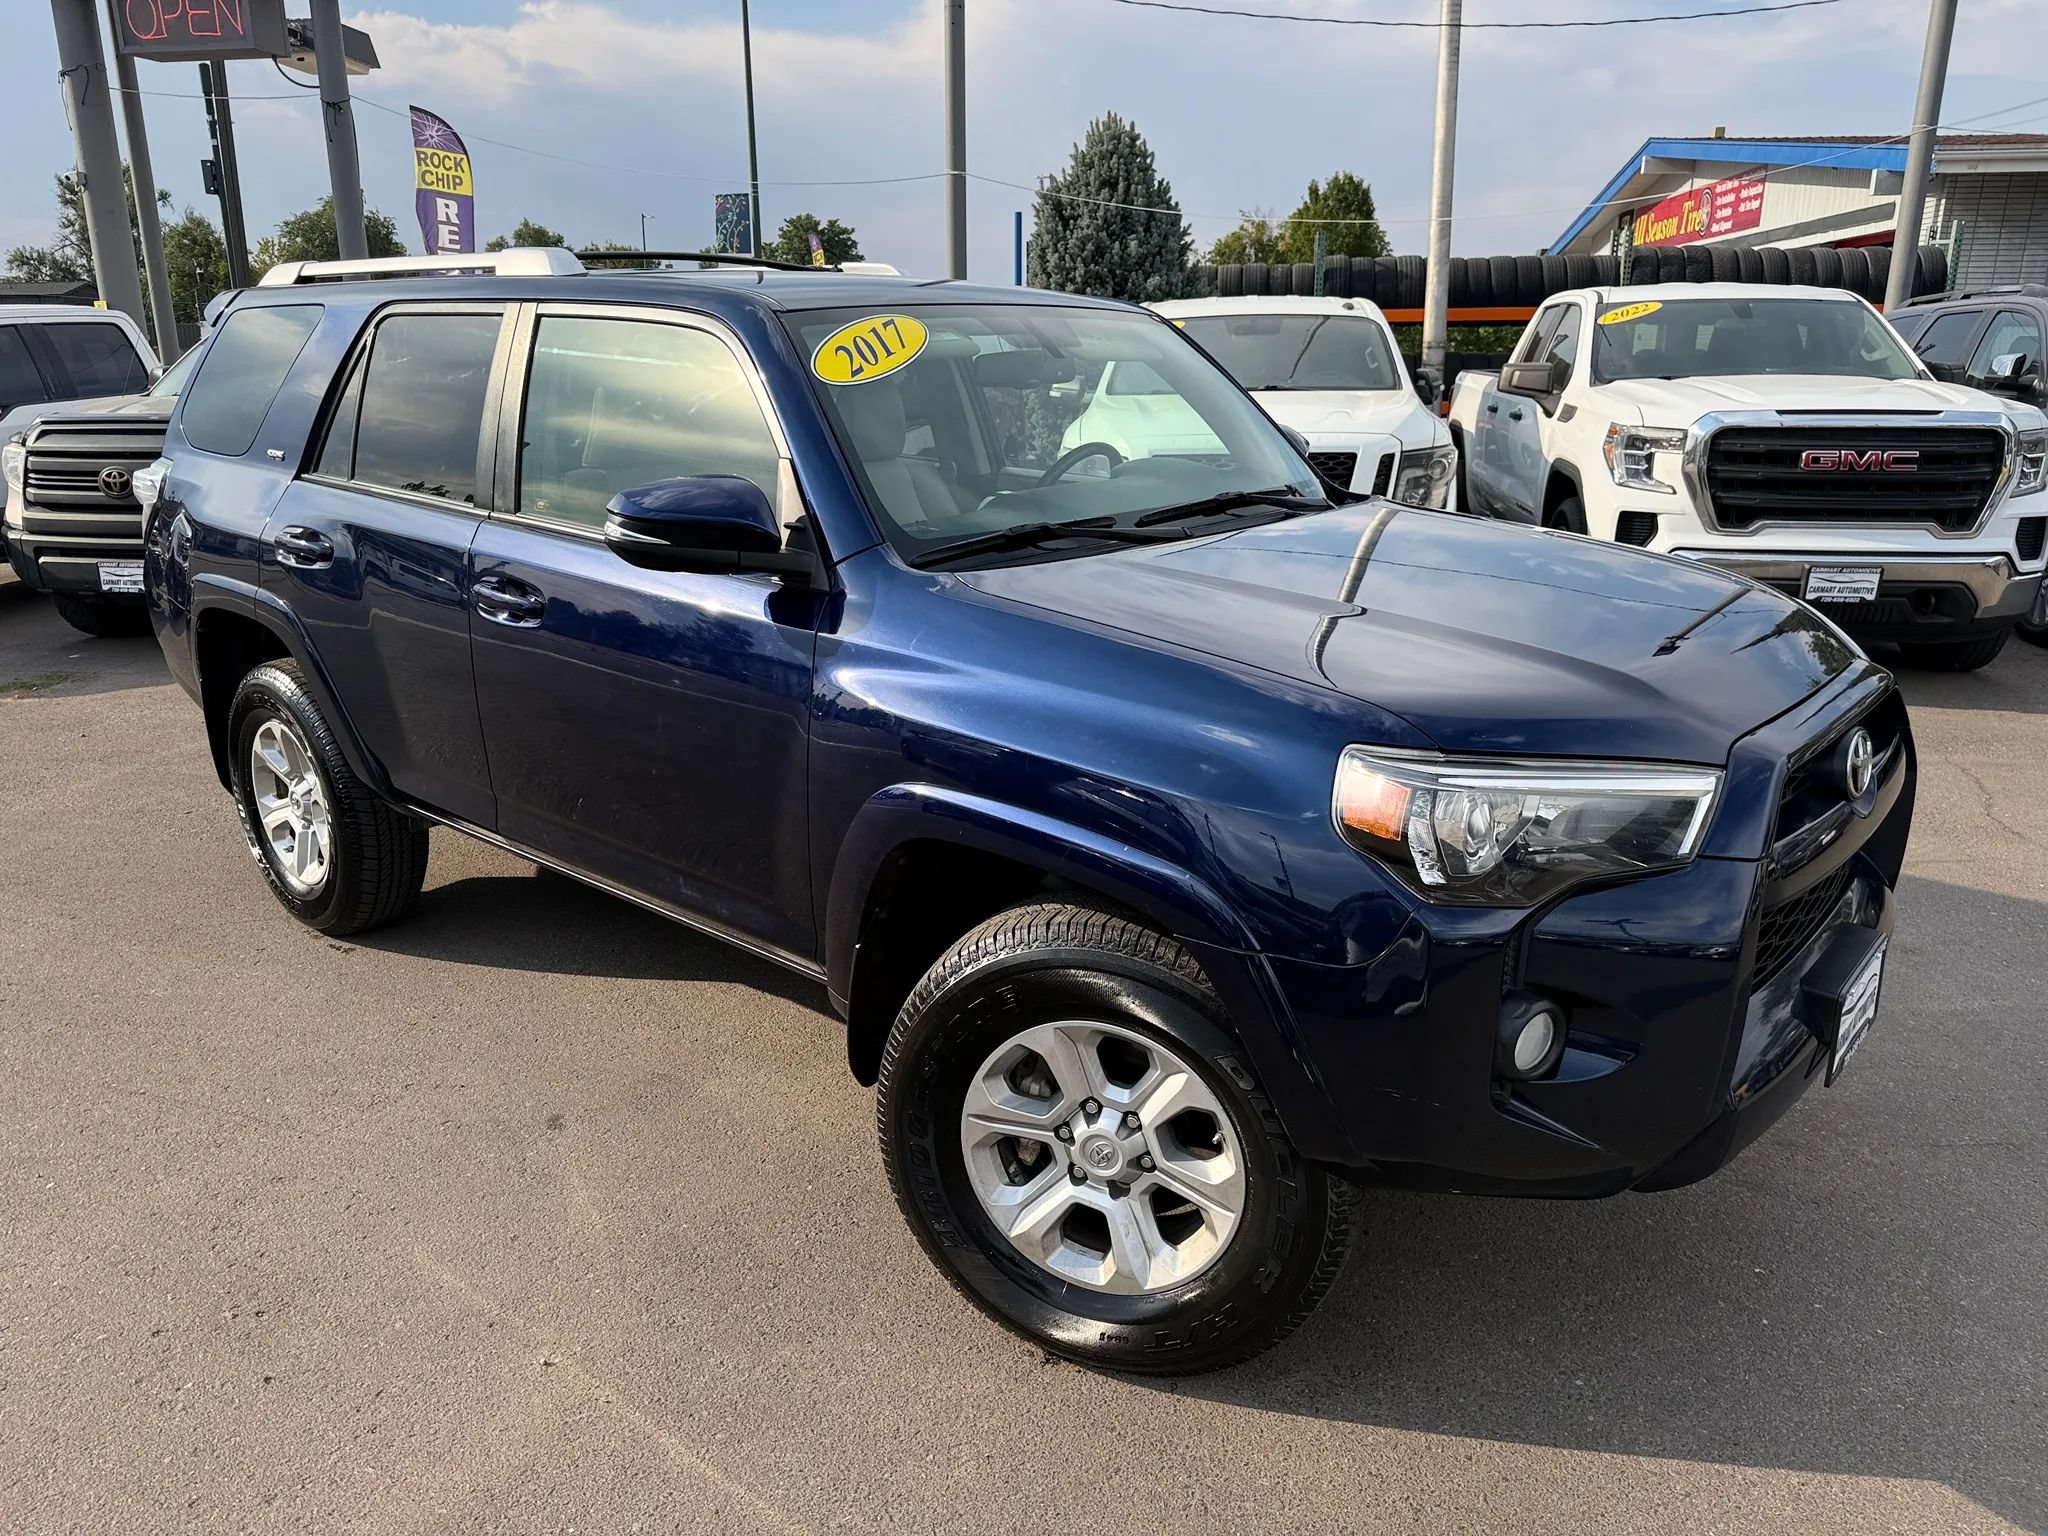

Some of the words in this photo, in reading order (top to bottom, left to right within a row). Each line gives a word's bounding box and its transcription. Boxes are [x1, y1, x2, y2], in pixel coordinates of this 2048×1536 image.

[126, 0, 243, 39] OPEN
[416, 150, 465, 174] ROCK
[420, 169, 463, 191] CHIP
[435, 197, 461, 255] RE
[1646, 212, 1679, 243] Season
[1611, 304, 1650, 321] 2022
[835, 319, 906, 379] 2017
[1801, 450, 1920, 471] GMC
[1808, 585, 1837, 594] CARMART
[1837, 586, 1876, 595] AUTOMOTIVE
